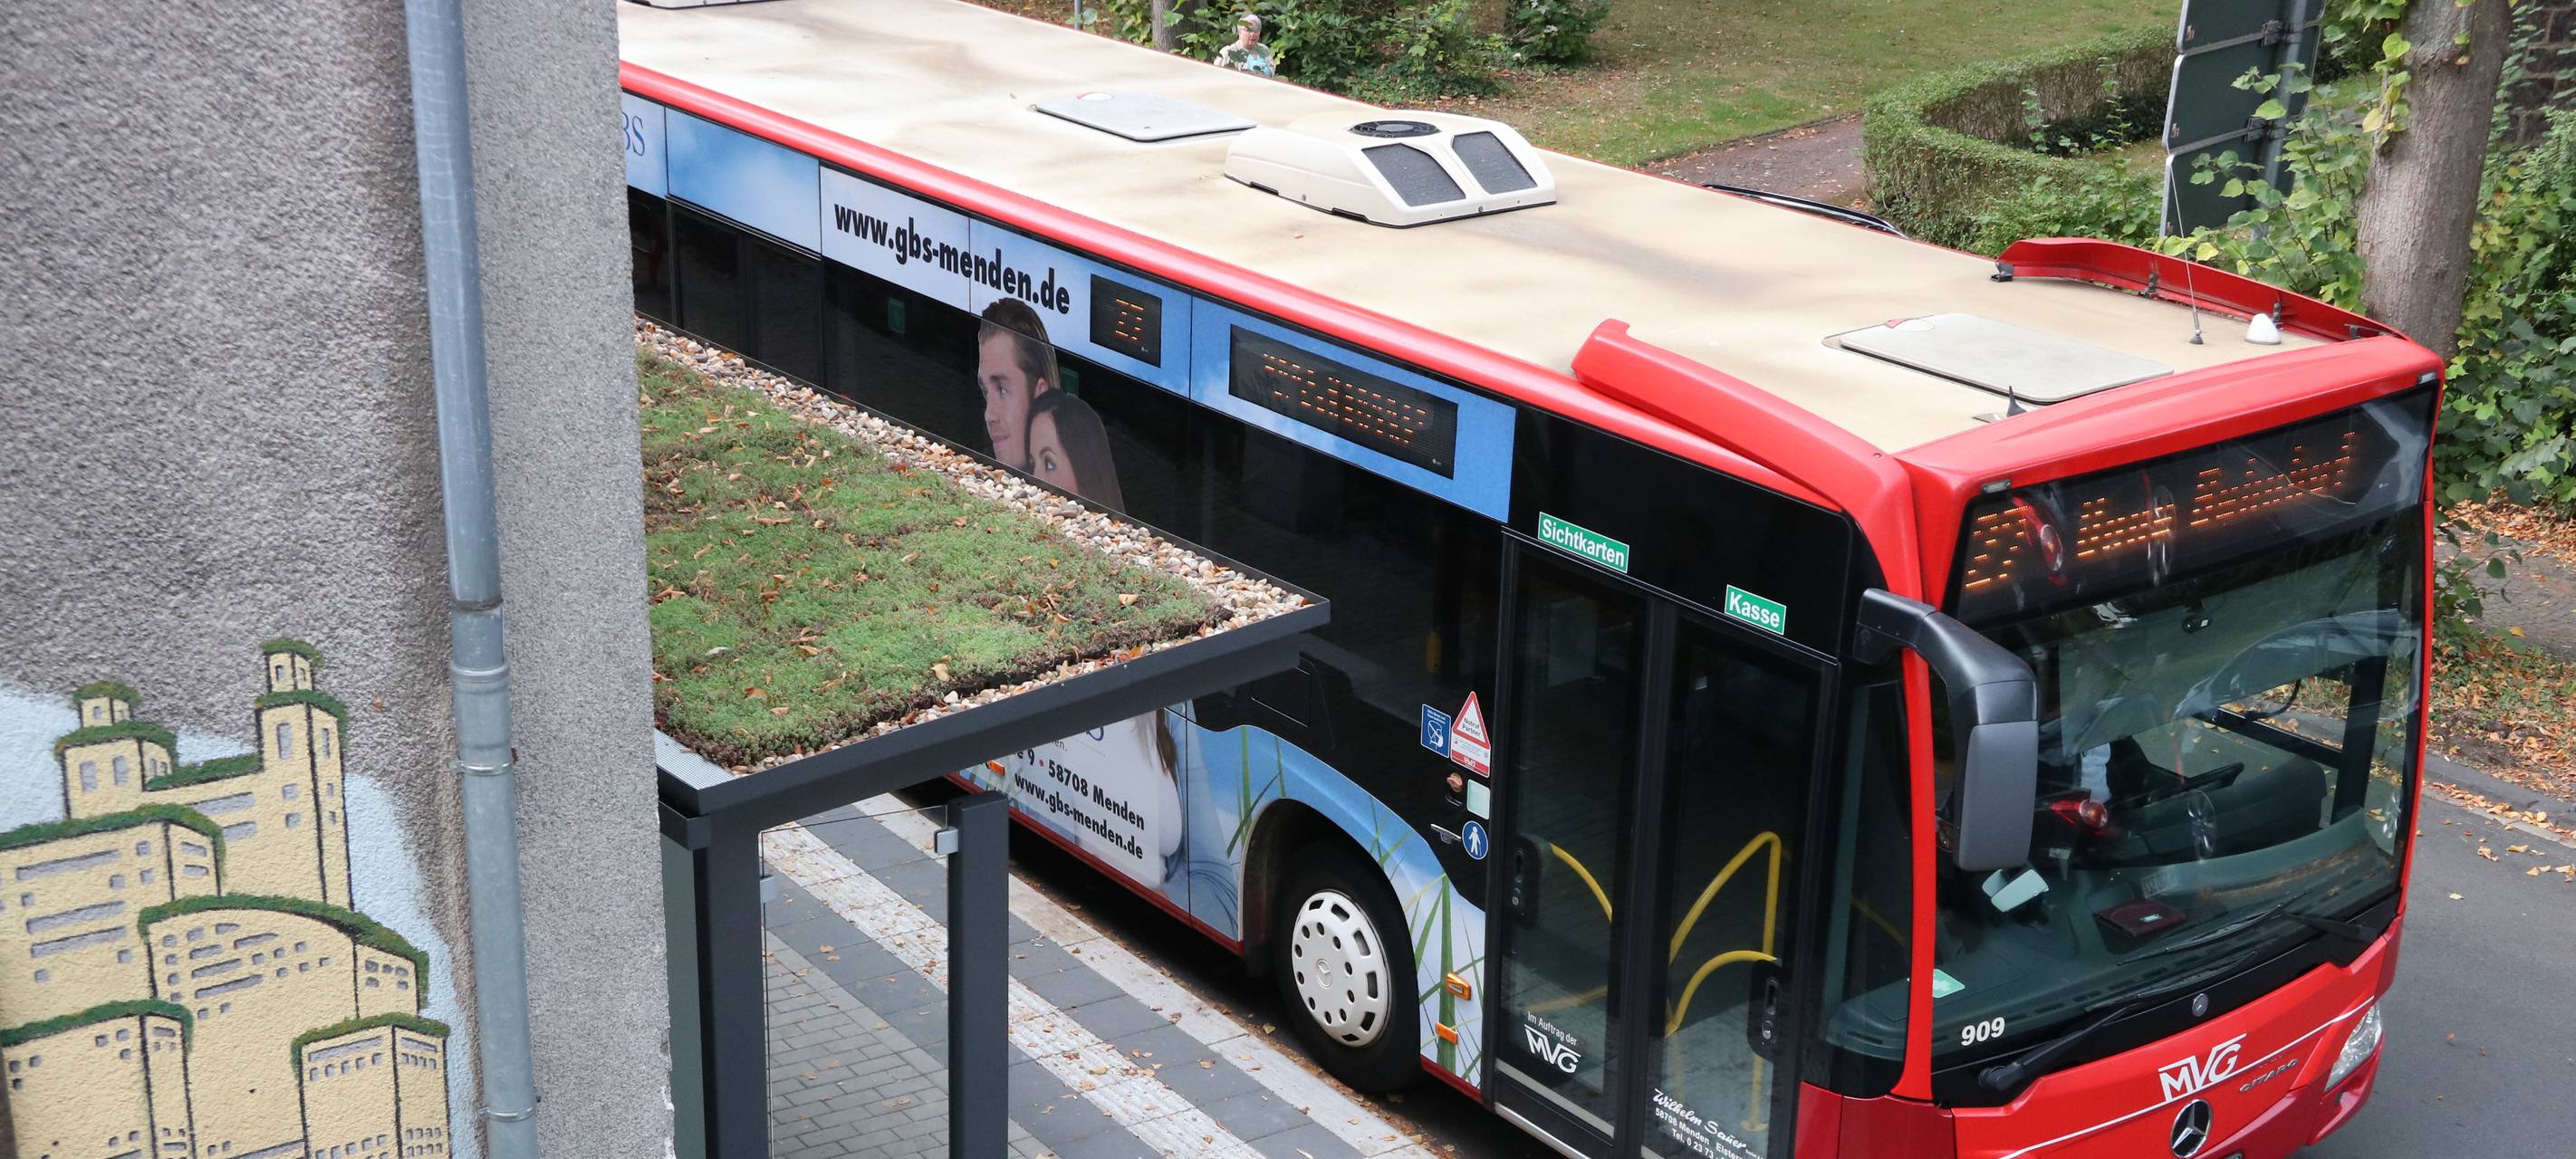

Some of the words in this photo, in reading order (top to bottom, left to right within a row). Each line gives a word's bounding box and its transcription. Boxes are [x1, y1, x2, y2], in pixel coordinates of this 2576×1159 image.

[834, 204, 1070, 314] www.gbs-menden.de
[1542, 518, 1625, 568] Sichtkarten
[1729, 591, 1780, 627] Kasse
[1028, 749, 1034, 766] 9
[1048, 759, 1089, 797] 58708
[1092, 785, 1145, 830] Menden
[1014, 772, 1143, 859] www.gbs-menden.de
[1524, 1024, 1581, 1073] MVG
[1528, 1011, 1537, 1024] Im
[1539, 1018, 1564, 1041] Auftrag
[1566, 1034, 1578, 1046] der
[1961, 1017, 2005, 1046] 909
[2158, 1033, 2246, 1102] MVG
[1653, 1087, 1702, 1125] Wilhelm
[1655, 1107, 1677, 1125] 58708
[1678, 1121, 1710, 1145] Menden
[1672, 1128, 1685, 1143] Tel.
[1687, 1137, 1692, 1146] 0
[1694, 1141, 1703, 1152] 23
[1705, 1146, 1714, 1159] 73
